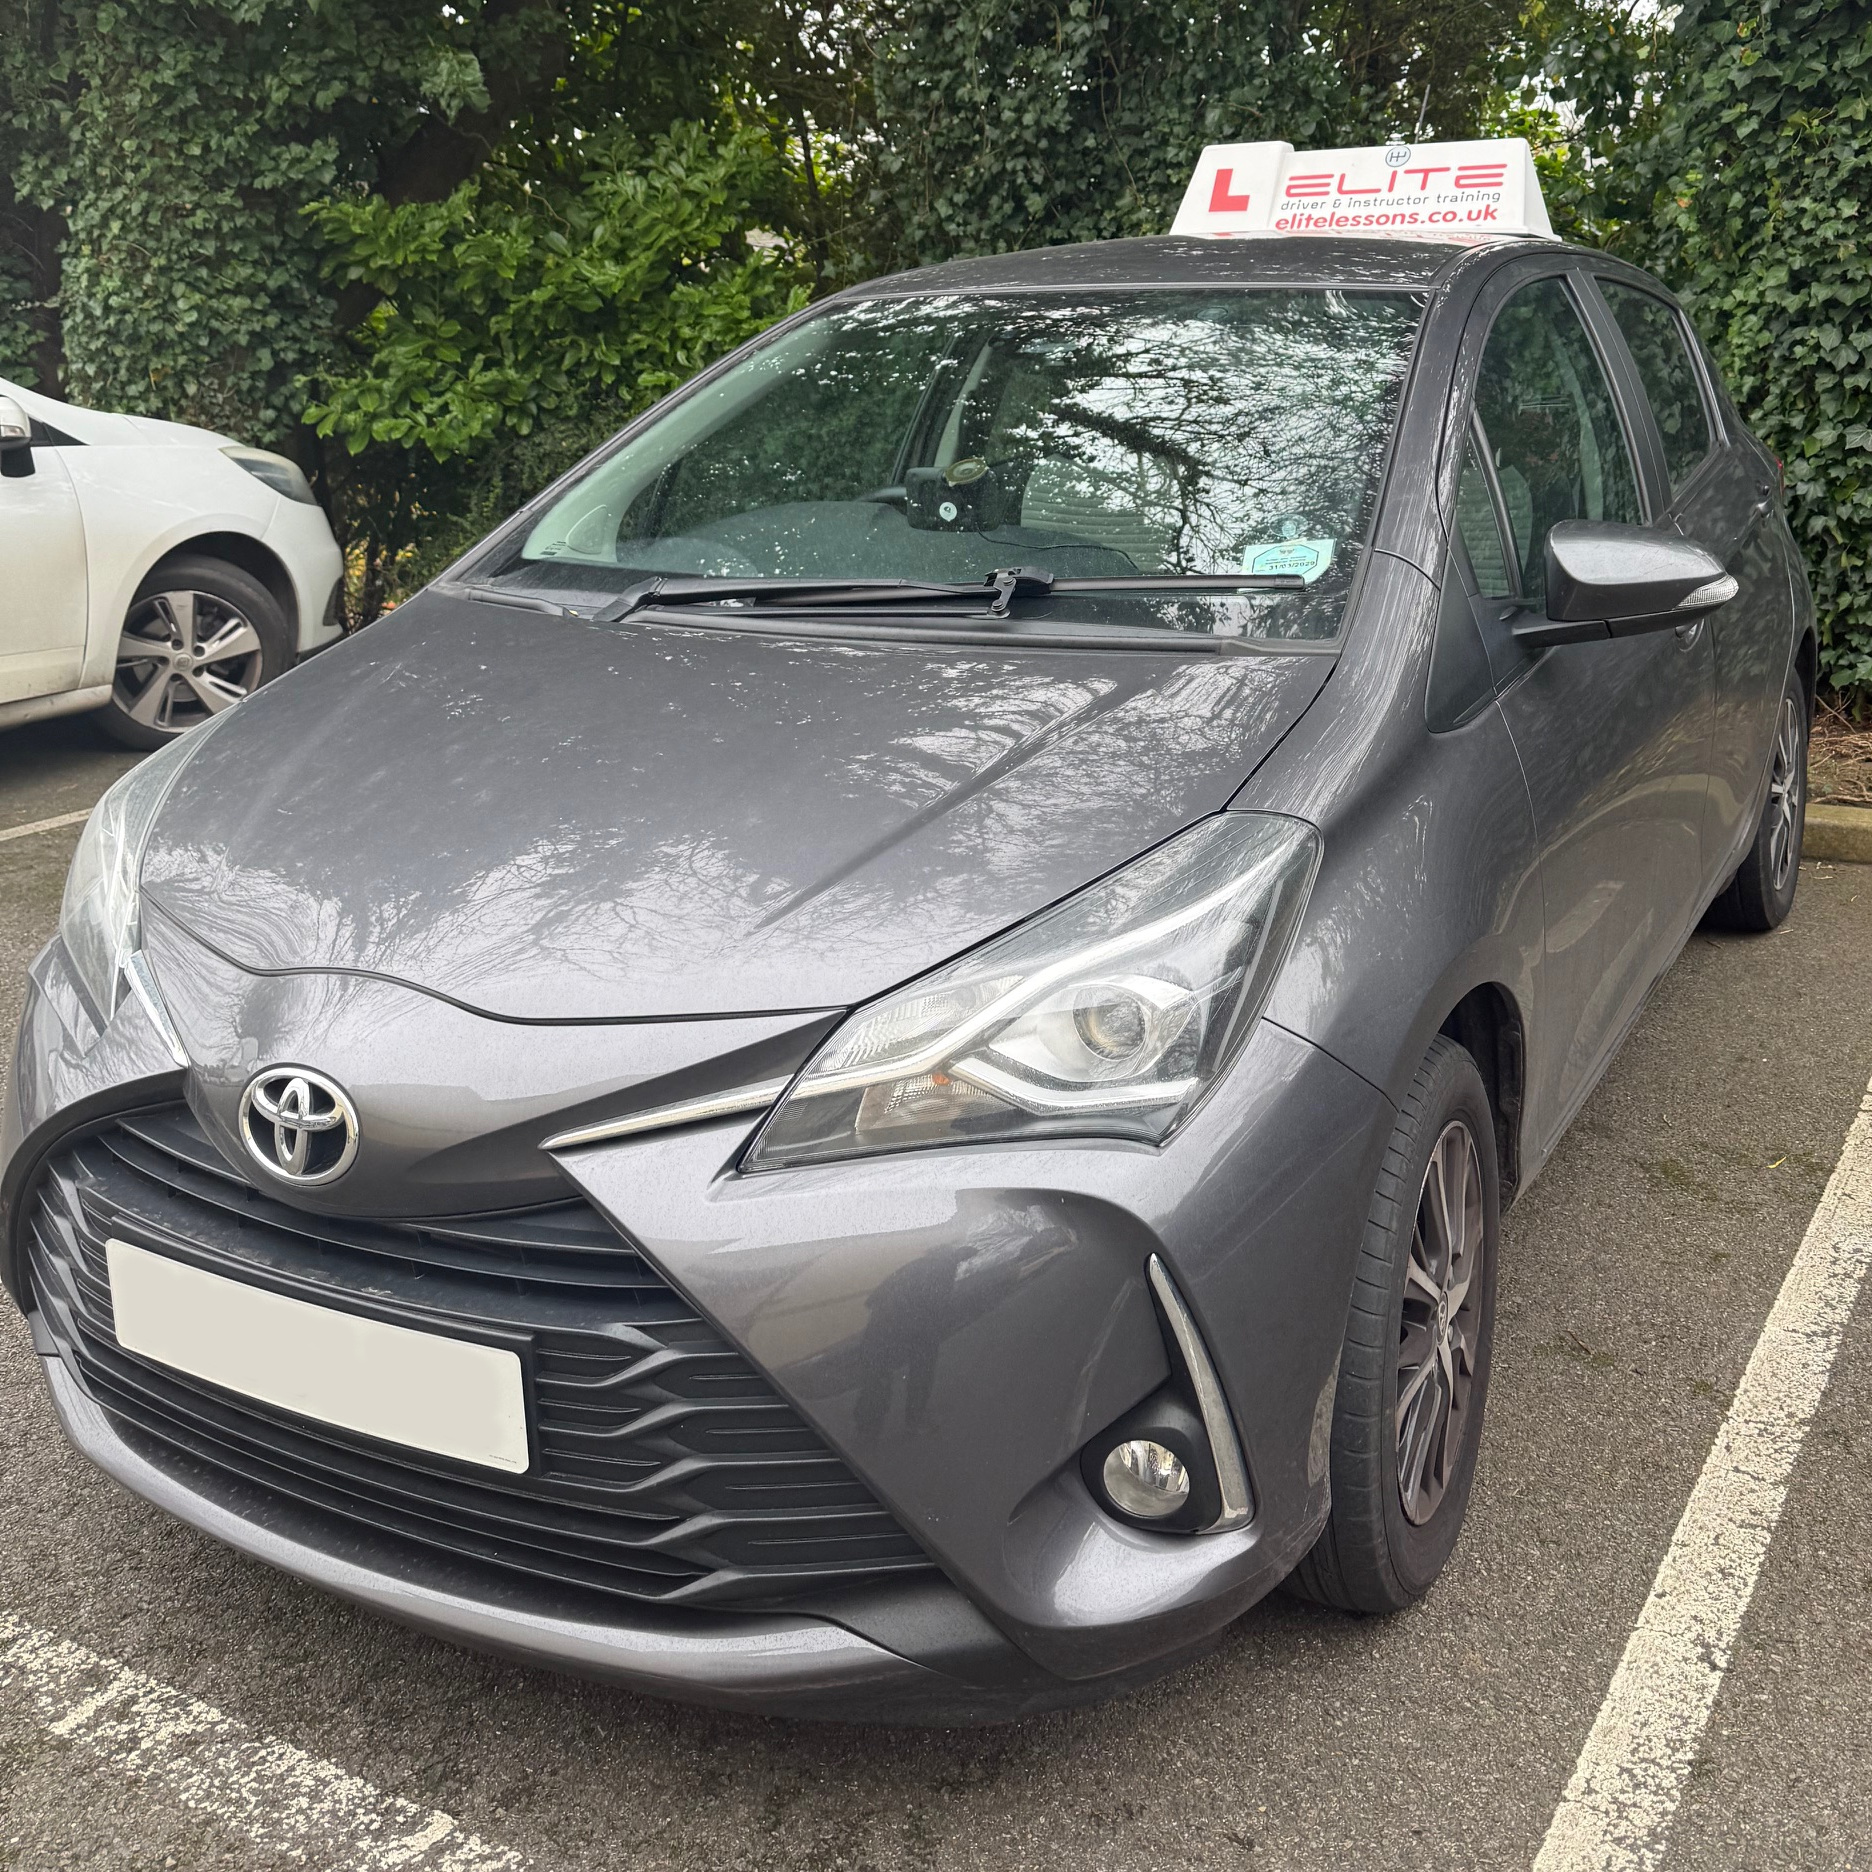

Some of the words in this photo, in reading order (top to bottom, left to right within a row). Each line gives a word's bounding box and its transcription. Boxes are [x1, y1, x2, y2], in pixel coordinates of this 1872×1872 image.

[1208, 168, 1250, 212] L
[1285, 163, 1507, 198] ELITE
[1280, 200, 1326, 211] driver
[1332, 198, 1342, 209] &
[1347, 195, 1429, 208] instructor
[1436, 190, 1501, 204] training
[1275, 204, 1498, 231] elitelessons.co.uk
